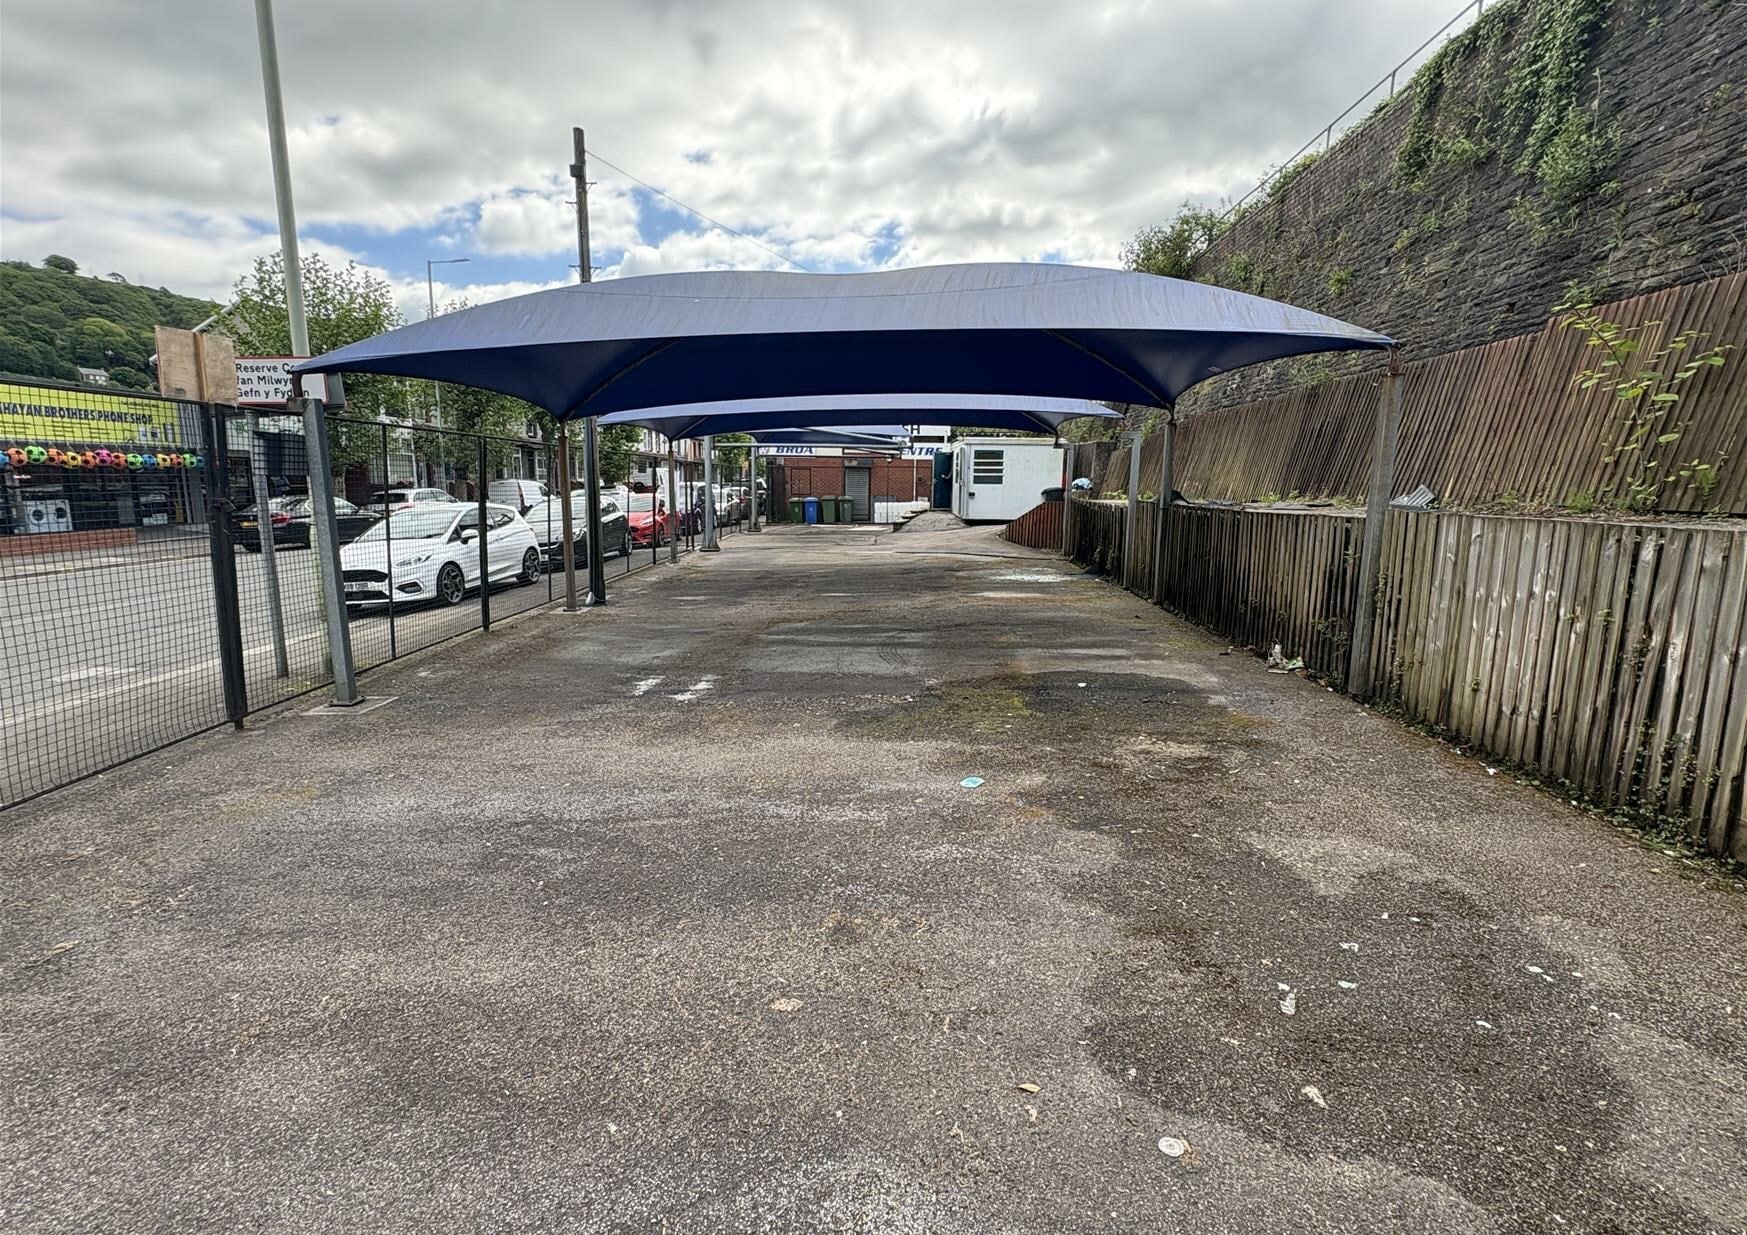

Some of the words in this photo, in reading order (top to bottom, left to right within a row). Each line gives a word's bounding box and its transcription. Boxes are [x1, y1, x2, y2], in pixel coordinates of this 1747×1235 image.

[235, 363, 278, 373] Reserve
[264, 390, 270, 399] y
[0, 402, 42, 417] HAYAN
[44, 406, 96, 421] BROTHERS
[97, 410, 129, 423] PHONE
[130, 413, 153, 425] SHOP
